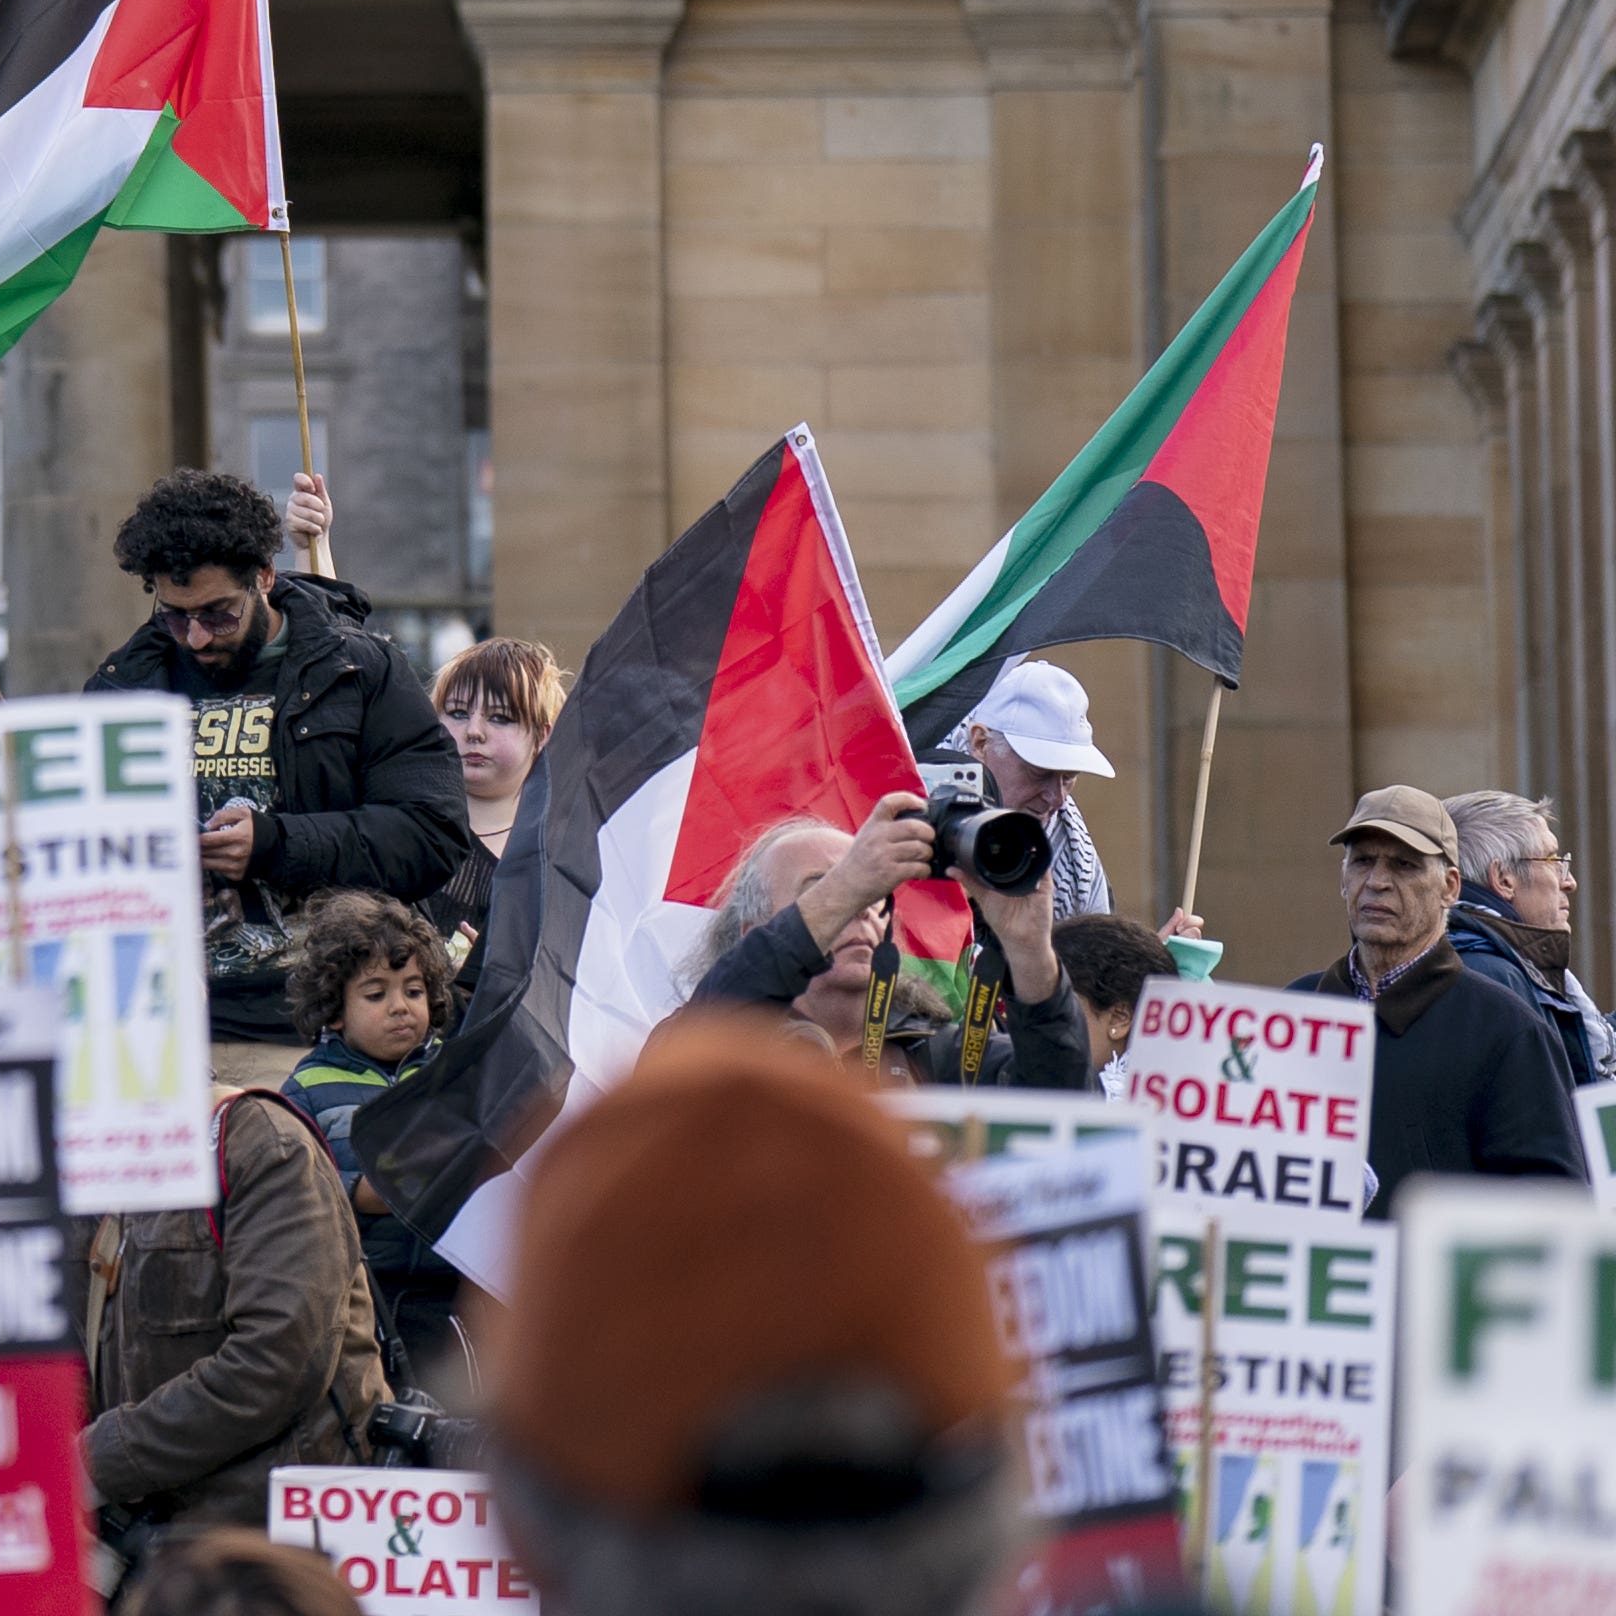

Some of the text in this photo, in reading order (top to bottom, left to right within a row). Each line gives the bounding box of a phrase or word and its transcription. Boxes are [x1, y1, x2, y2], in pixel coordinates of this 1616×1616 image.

[188, 757, 276, 777] PPRESSE
[865, 979, 887, 1069] Nikon D850
[964, 984, 990, 1072] Nikon D850
[1142, 999, 1364, 1061] BOYCOTT
[1221, 1036, 1258, 1081] &
[1129, 1072, 1358, 1141] ISOLATE
[1160, 1140, 1352, 1212] RAEL
[1154, 1234, 1376, 1329] REE
[1160, 1348, 1376, 1403] ESTINE
[282, 1486, 492, 1527] BOYCOT
[387, 1515, 423, 1557] &
[338, 1556, 531, 1599] OLATE
